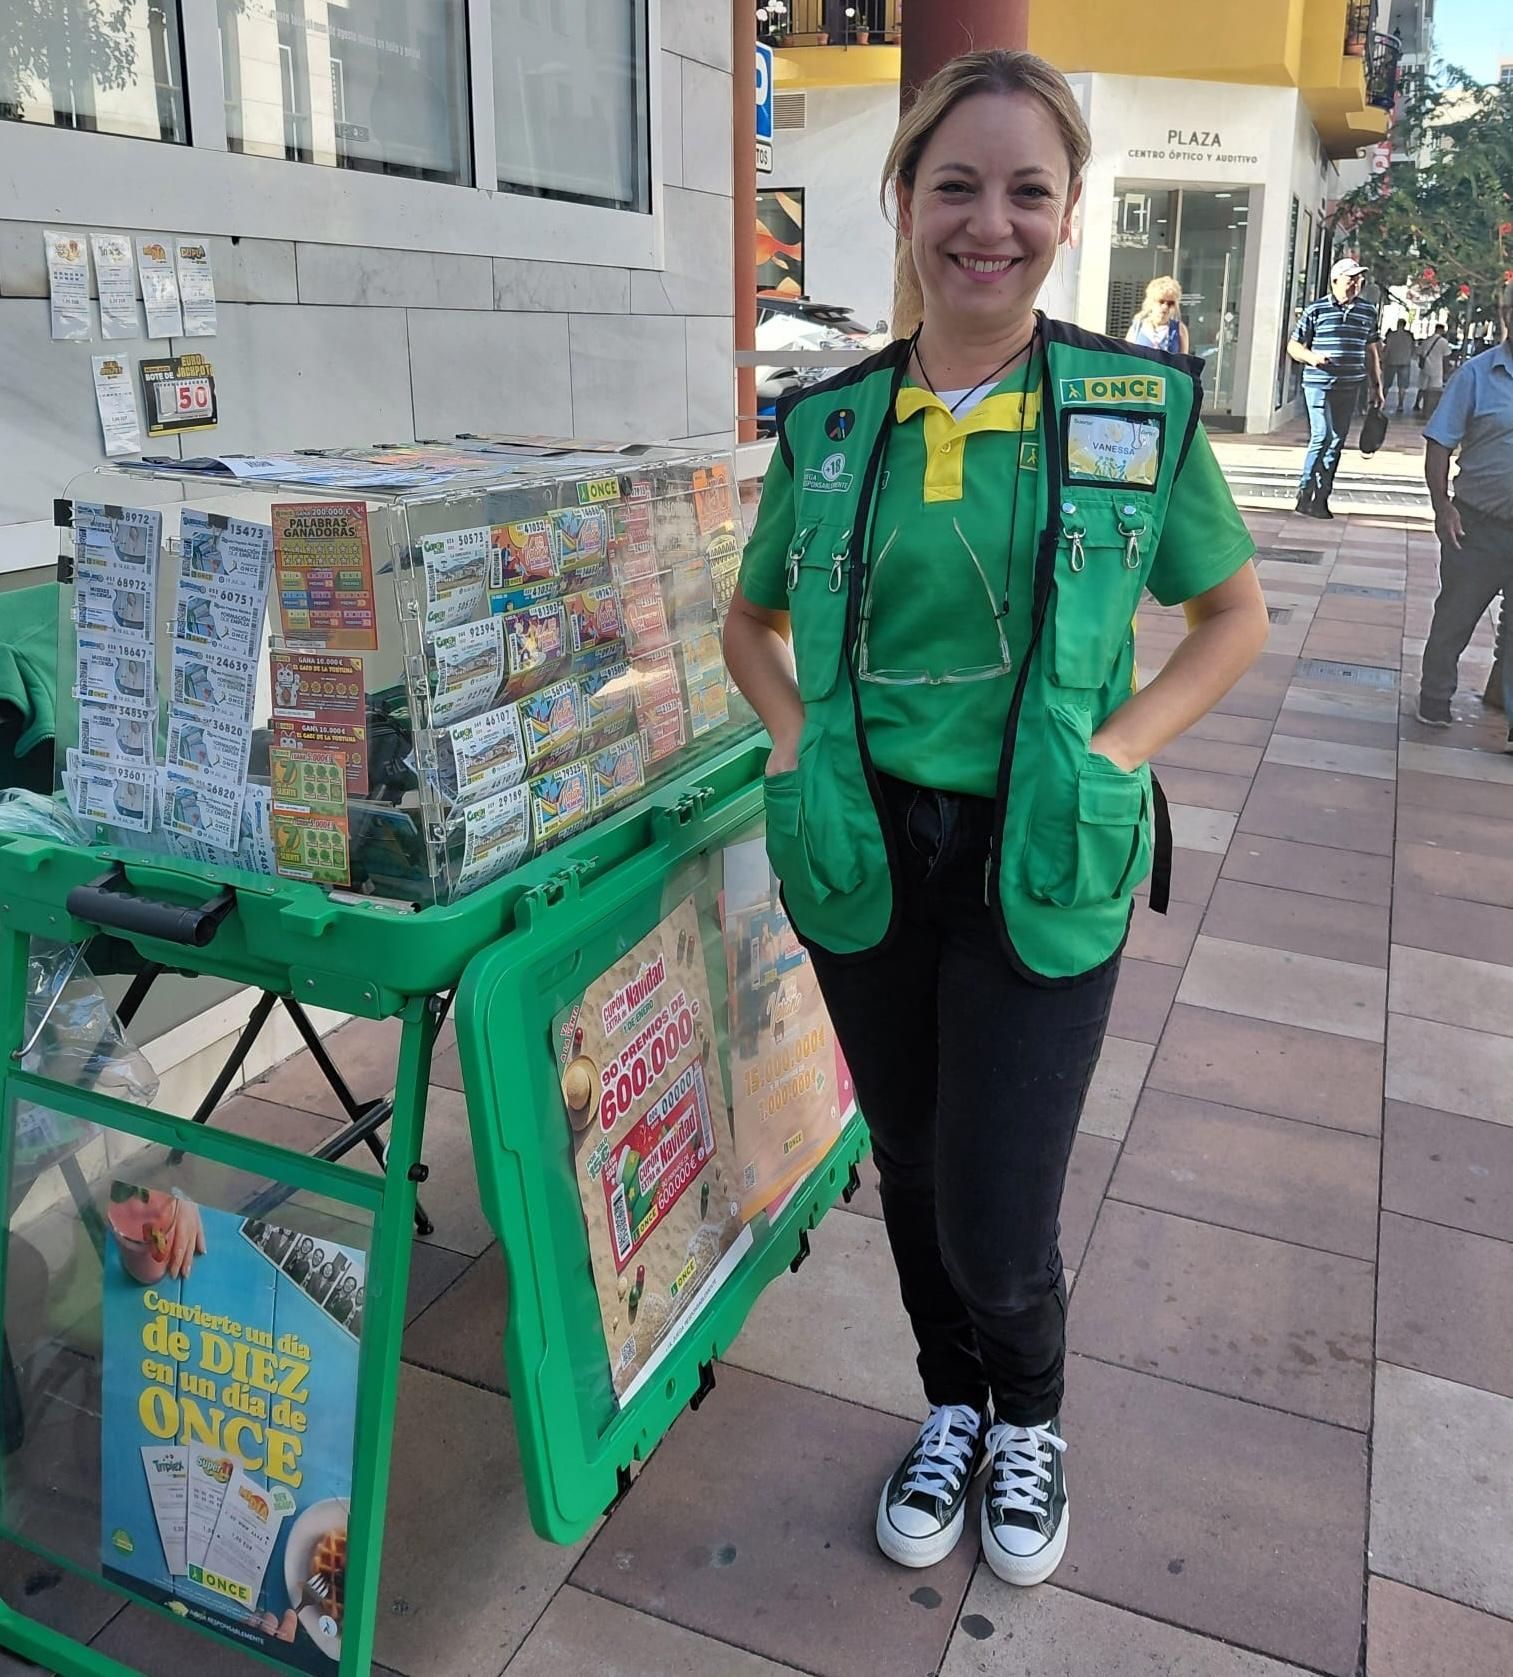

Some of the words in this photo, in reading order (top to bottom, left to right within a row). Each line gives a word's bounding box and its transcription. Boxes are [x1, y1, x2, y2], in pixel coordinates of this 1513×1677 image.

[1168, 129, 1222, 147] PLAZA
[1128, 149, 1165, 160] CENTRO
[1168, 149, 1203, 161] ÓPTICO
[1206, 154, 1212, 162] Y
[1215, 154, 1258, 164] AUDITIVO
[181, 354, 203, 366] EURO
[145, 372, 164, 381] BOTE
[164, 371, 174, 379] DE
[177, 364, 212, 378] JACKPOT
[179, 386, 208, 409] 50
[1091, 380, 1159, 398] ONCE
[1092, 441, 1135, 455] VANESSA
[826, 458, 842, 476] +18
[590, 481, 618, 498] ONCE
[311, 508, 344, 516] 200.000
[230, 523, 264, 539] 15473
[289, 518, 348, 529] PALABRAS
[524, 521, 545, 533] 41032
[283, 527, 356, 538] GANADORAS
[458, 532, 484, 546] 50573
[240, 566, 259, 574] ONCE
[117, 576, 147, 591] 68972
[220, 590, 254, 607] 60751
[231, 632, 248, 641] ONCE
[469, 622, 495, 638] 92394
[119, 645, 147, 659] 18647
[216, 656, 249, 673] 24639
[299, 656, 315, 664] GANA
[316, 657, 338, 666] 10.000
[119, 705, 149, 720] 34859
[485, 709, 510, 727] 46107
[213, 719, 243, 737] 36820
[302, 724, 319, 732] GANA
[319, 725, 341, 734] 10.000
[117, 767, 146, 783] 93601
[606, 1014, 622, 1033] EXTRA
[625, 957, 665, 1013] Navidad
[603, 990, 626, 1021] CUPÓN
[602, 1062, 619, 1085] 90
[619, 1012, 670, 1067] PREMIOS
[670, 992, 685, 1014] DE
[661, 1071, 693, 1115] 00000
[641, 1167, 656, 1192] EXTRA
[659, 1108, 697, 1168] Navidad
[788, 1135, 802, 1149] ONCE
[640, 1208, 657, 1231] ONCE
[677, 1260, 695, 1286] ONCE
[143, 1289, 242, 1338] Convierte
[245, 1326, 273, 1350] un
[276, 1333, 312, 1361] día
[142, 1314, 192, 1362] de
[199, 1330, 310, 1405] DIEZ
[141, 1358, 175, 1387] en
[179, 1371, 217, 1402] un
[221, 1382, 267, 1420] día
[271, 1400, 308, 1433] de
[138, 1385, 304, 1489] ONCE
[206, 1574, 248, 1601] ONCE
[207, 1616, 265, 1645] RESPONSABLEMENTE
